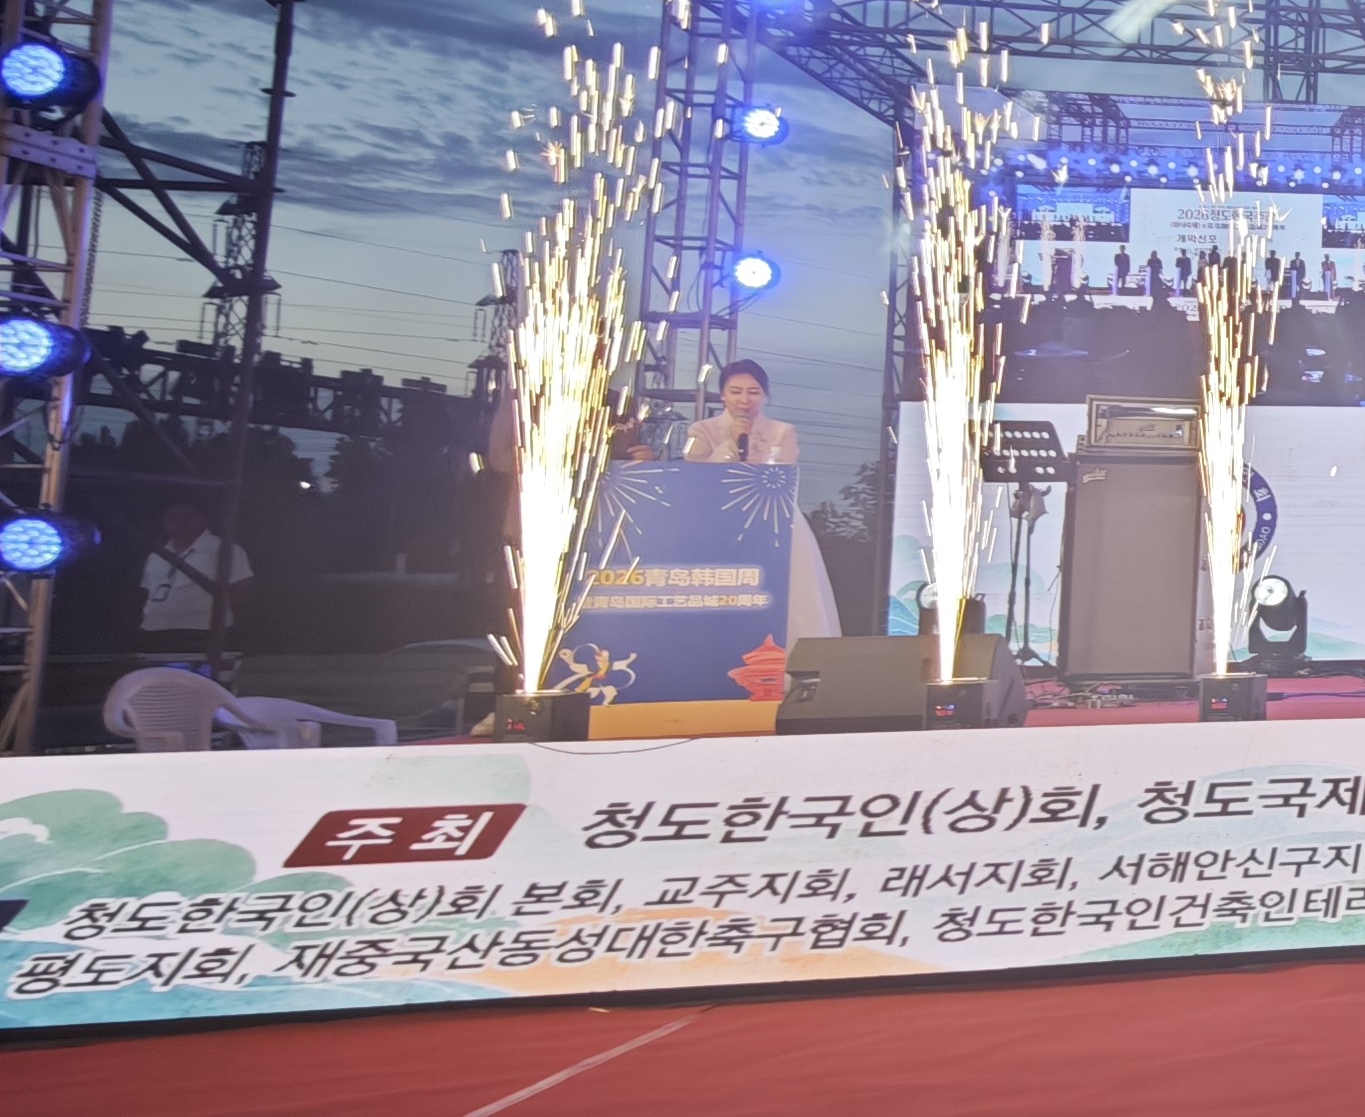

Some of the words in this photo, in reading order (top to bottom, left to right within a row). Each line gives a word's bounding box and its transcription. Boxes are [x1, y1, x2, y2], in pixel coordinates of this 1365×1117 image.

[582, 782, 1107, 850] 청도한국인(상)회,
[63, 883, 502, 941] 청도한국인(상)회
[511, 877, 624, 917] 본회,
[653, 866, 858, 908] 교주지회,
[878, 854, 1080, 901] 래서지회,
[12, 942, 253, 995] 평도지회,
[274, 912, 911, 983] 재중국산동성대한축구협회,
